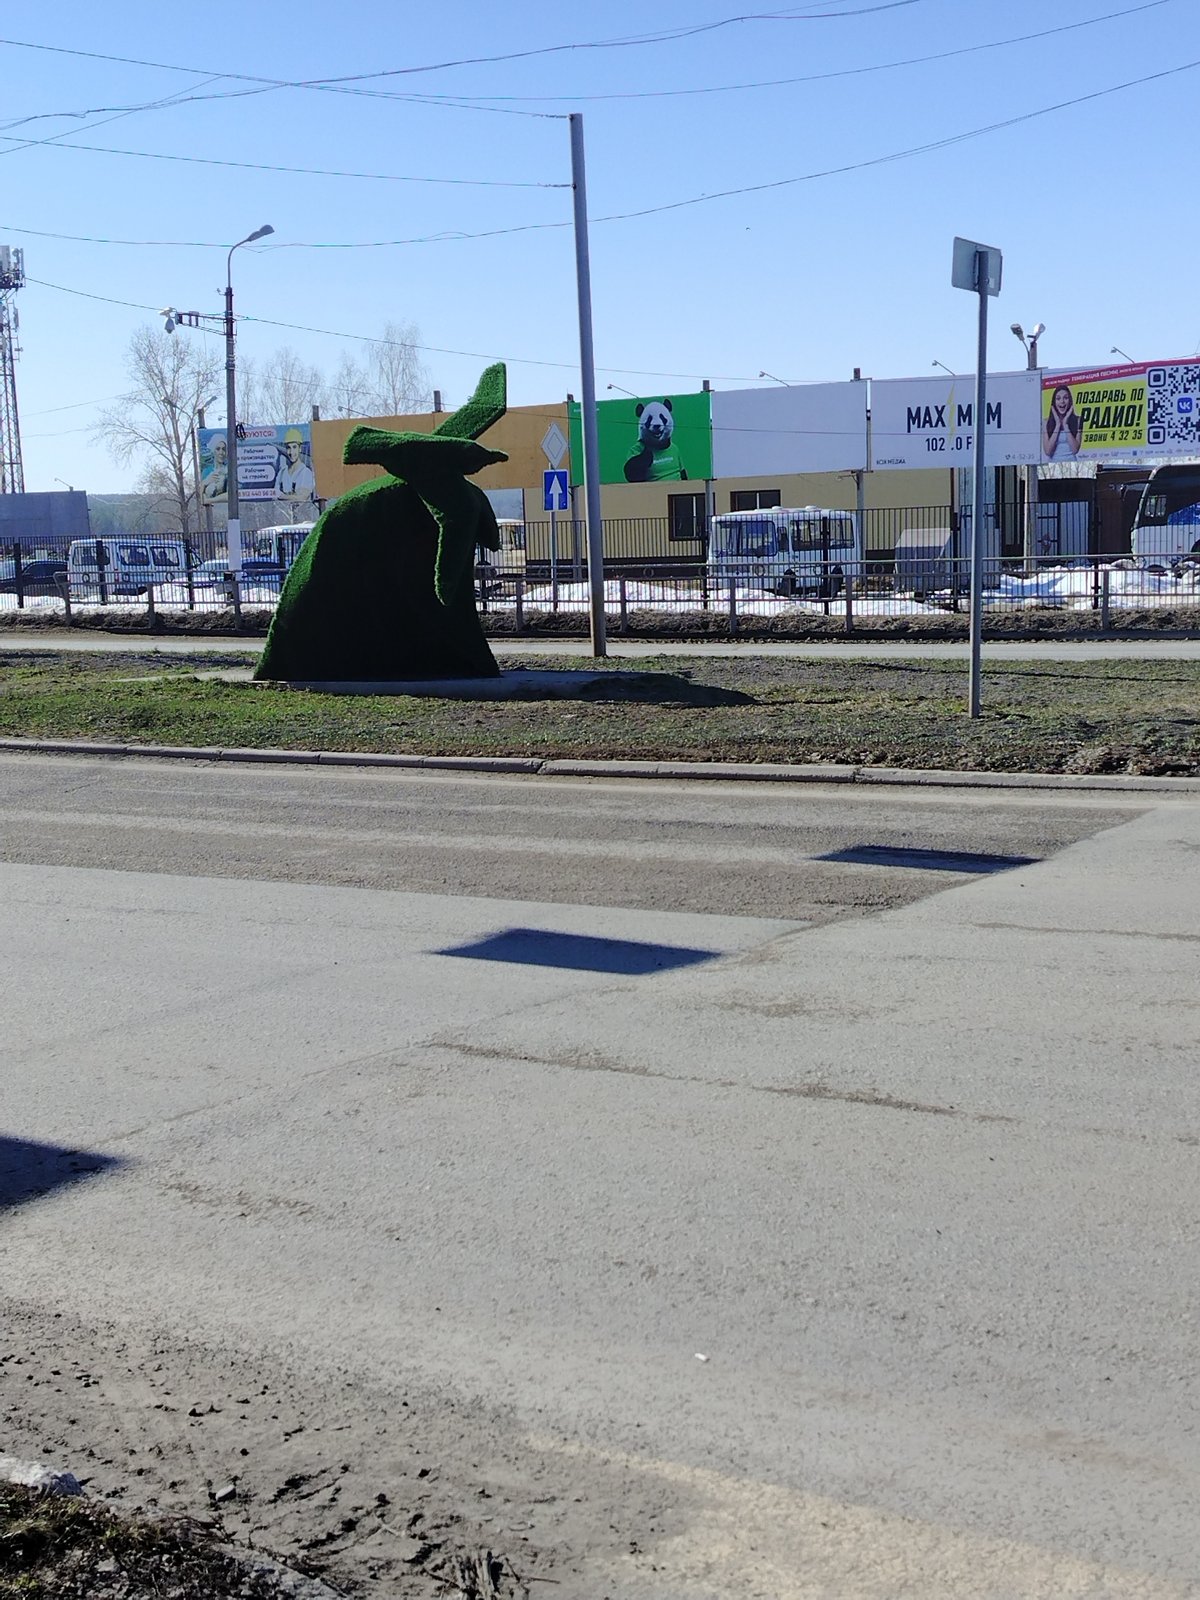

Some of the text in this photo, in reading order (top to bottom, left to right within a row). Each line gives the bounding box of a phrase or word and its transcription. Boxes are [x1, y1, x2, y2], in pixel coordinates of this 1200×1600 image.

[1075, 388, 1144, 404] ПОЗДРАВЬ ПО
[1079, 404, 1144, 430] РАДИО!
[1110, 431, 1116, 441] 4
[1118, 430, 1130, 441] 32
[1132, 429, 1143, 440] 35
[966, 436, 973, 450] F
